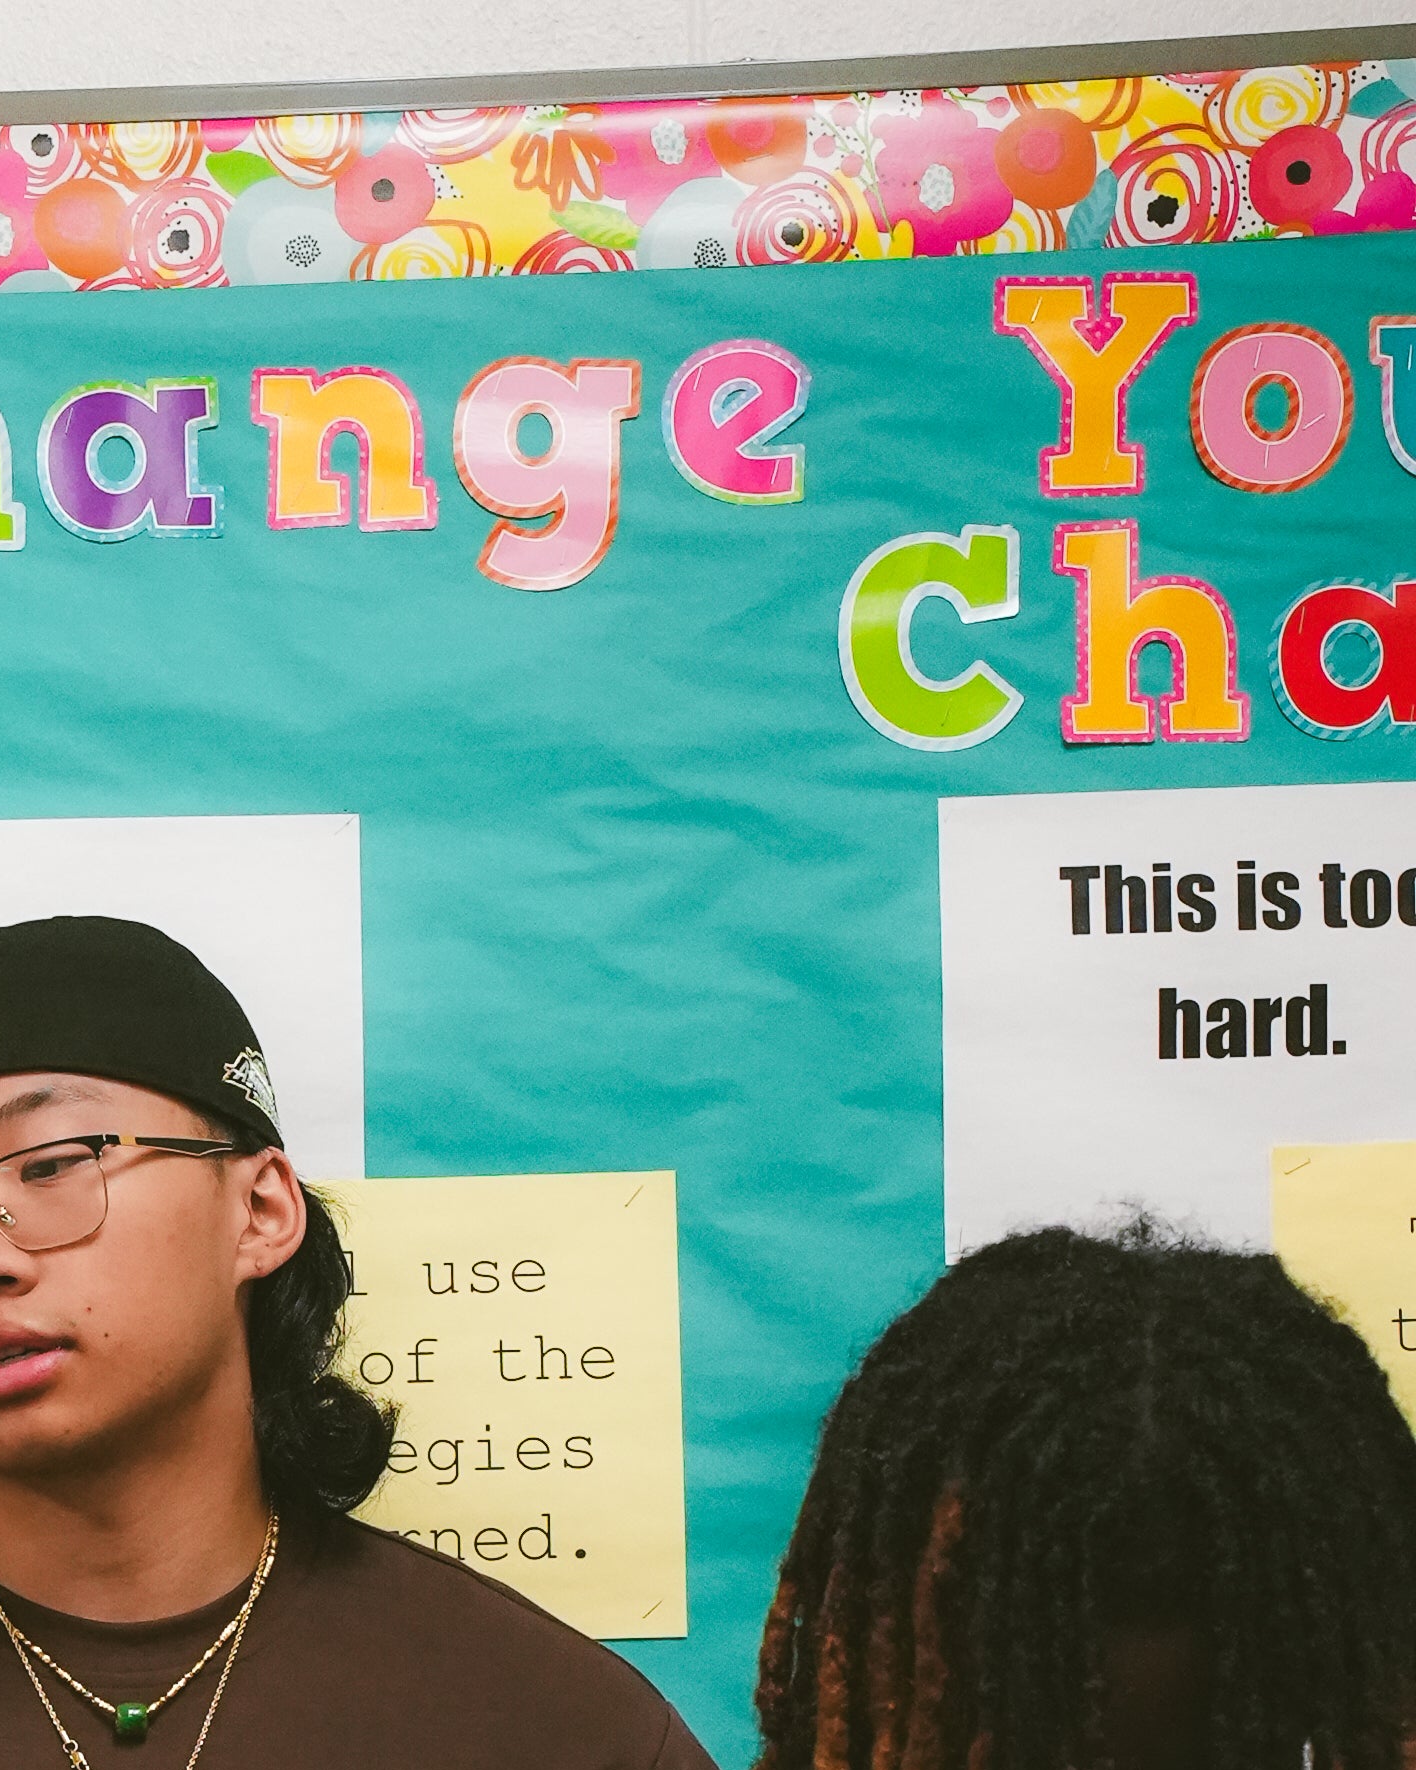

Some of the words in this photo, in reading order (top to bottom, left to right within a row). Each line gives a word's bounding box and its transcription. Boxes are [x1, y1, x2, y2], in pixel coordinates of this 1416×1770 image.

[993, 271, 1416, 498] Yo
[1059, 862, 1217, 936] This
[1236, 861, 1302, 931] is
[1158, 983, 1347, 1060] hard.
[422, 1259, 547, 1295] use
[359, 1338, 438, 1385] of
[492, 1335, 616, 1382] the
[386, 1424, 594, 1485] egies
